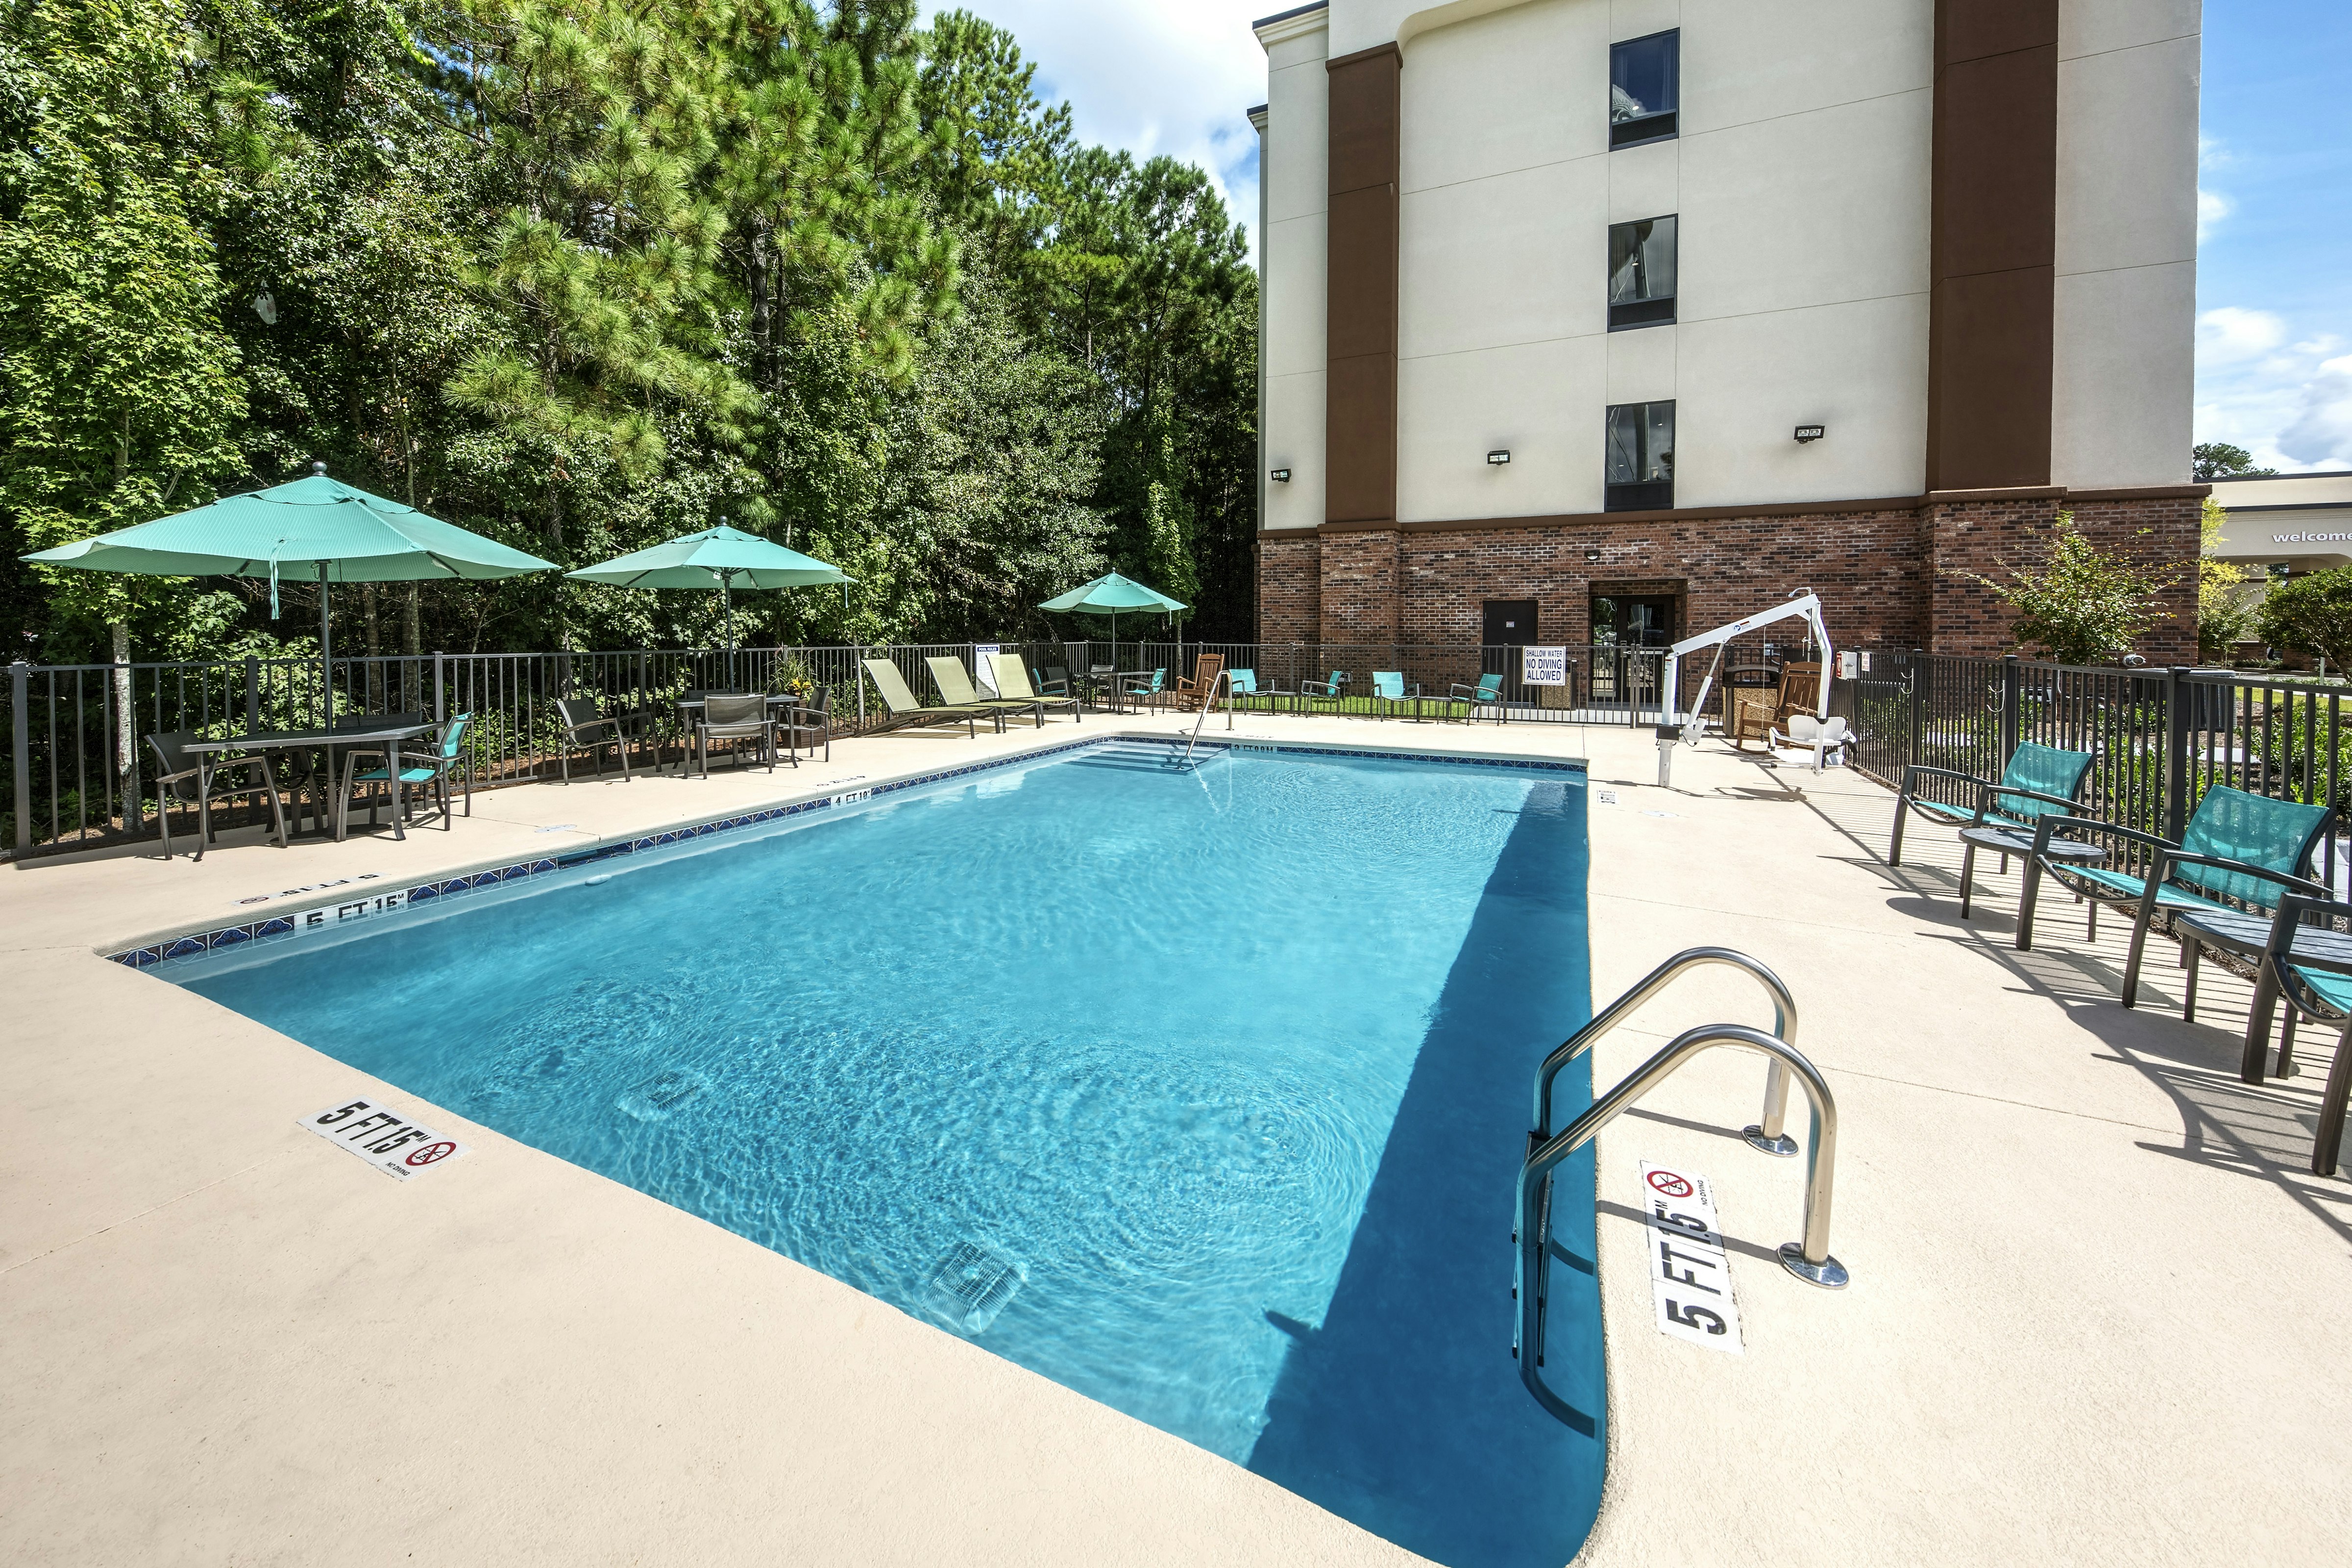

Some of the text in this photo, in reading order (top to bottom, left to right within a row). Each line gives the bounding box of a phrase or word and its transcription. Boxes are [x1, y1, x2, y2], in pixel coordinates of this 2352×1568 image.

[2272, 531, 2352, 542] welcome
[1526, 659, 1562, 669] NO DIVING
[1527, 670, 1561, 681] ALLOWED
[307, 911, 324, 925] 5
[339, 902, 368, 918] FT
[317, 1101, 370, 1125] 5
[334, 1112, 403, 1141] FT
[392, 1166, 410, 1176] DIVING
[1697, 1180, 1708, 1206] NO DIVING
[1660, 1241, 1721, 1296] FT
[1666, 1298, 1727, 1335] 5
